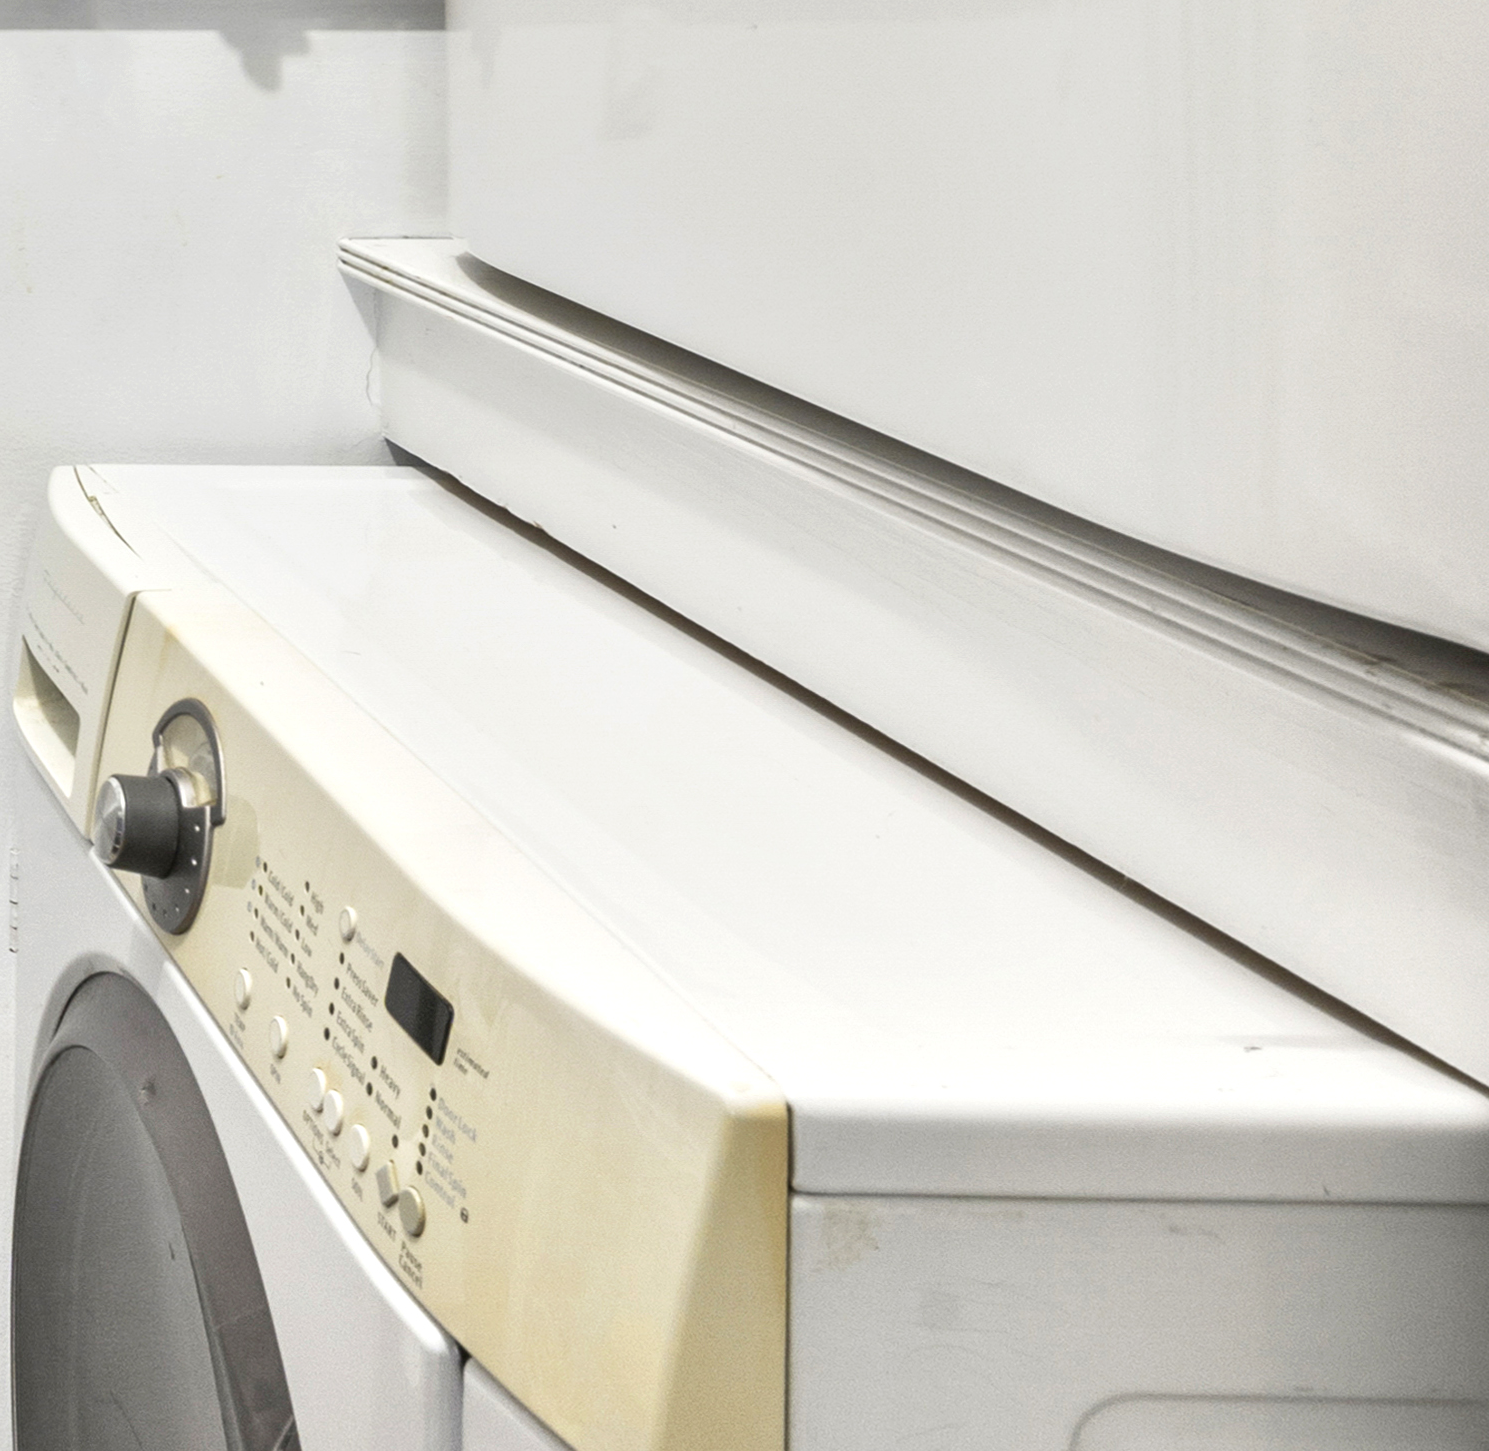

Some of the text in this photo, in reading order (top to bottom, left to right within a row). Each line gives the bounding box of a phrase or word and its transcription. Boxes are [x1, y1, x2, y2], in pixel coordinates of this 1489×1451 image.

[311, 891, 324, 915] High
[306, 914, 318, 937] Med
[453, 1058, 469, 1076] time
[456, 1047, 490, 1080] estimated
[379, 1064, 401, 1099] Heavy
[375, 1090, 402, 1130] Normal
[436, 1115, 456, 1144] Wash
[432, 1133, 454, 1163] Rinse
[424, 1171, 456, 1209] Control
[377, 1211, 397, 1242] START
[398, 1253, 423, 1290] Cancel
[401, 1239, 423, 1273] Pause
